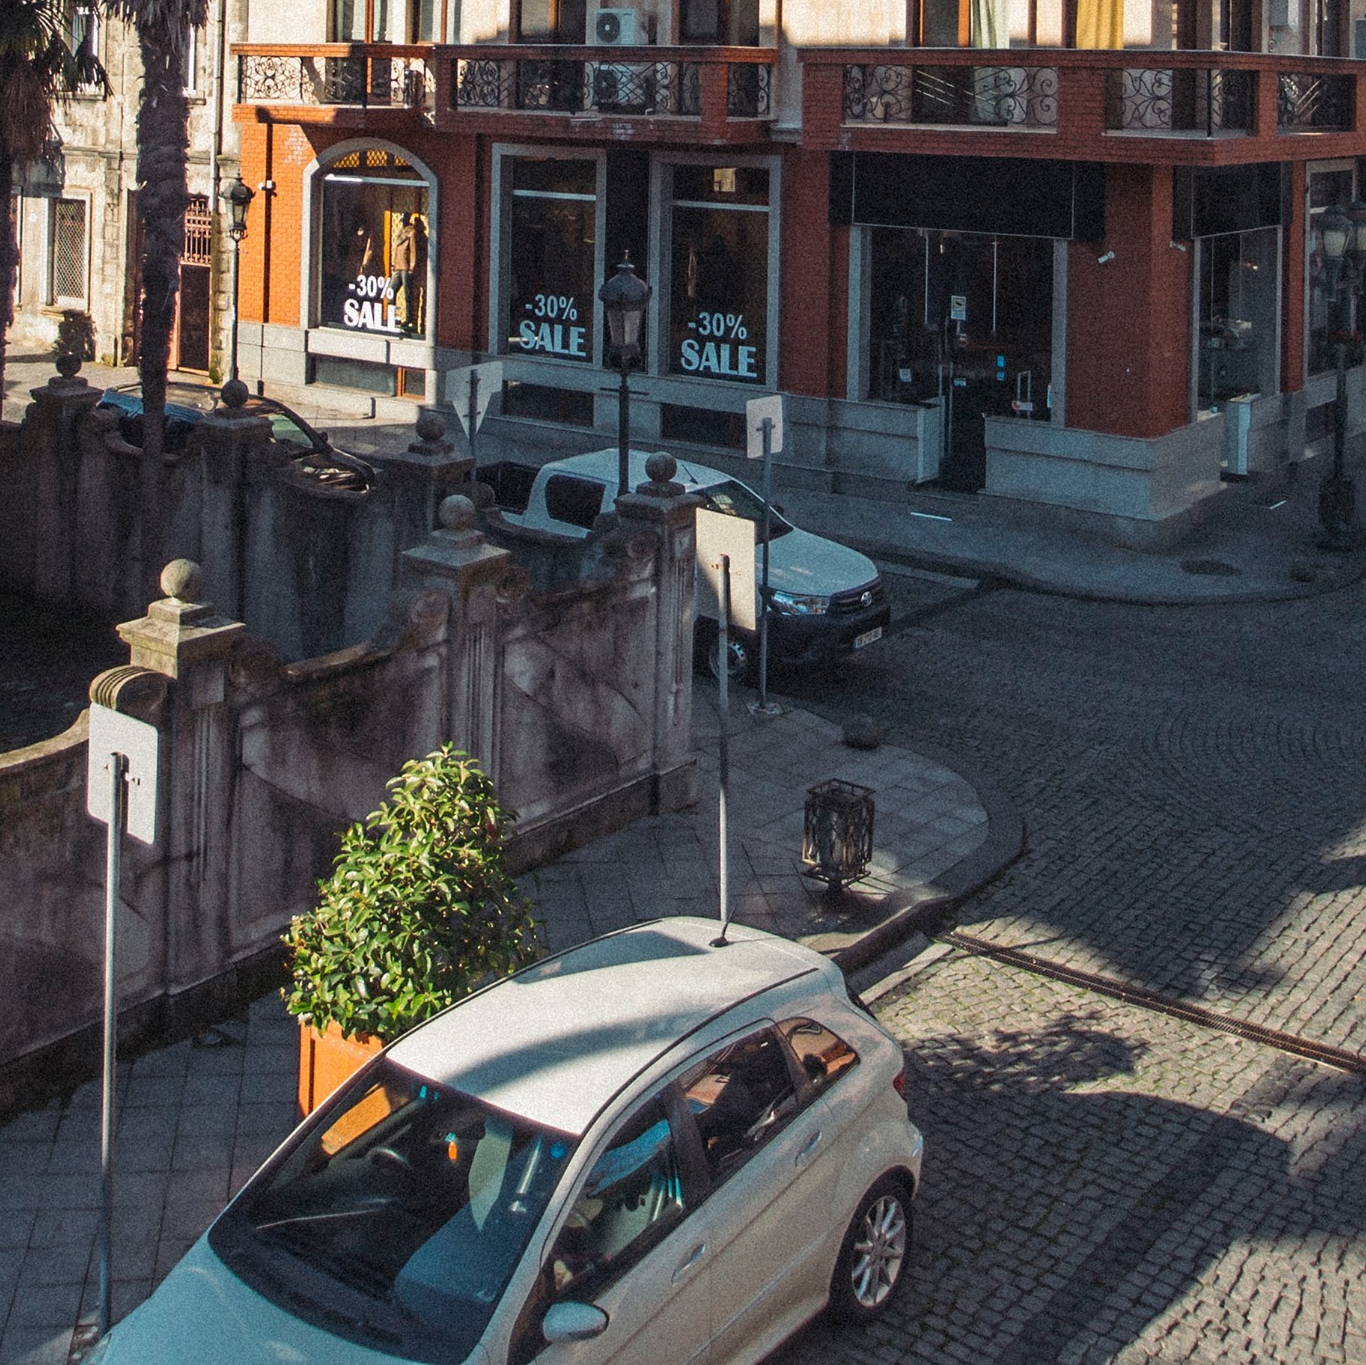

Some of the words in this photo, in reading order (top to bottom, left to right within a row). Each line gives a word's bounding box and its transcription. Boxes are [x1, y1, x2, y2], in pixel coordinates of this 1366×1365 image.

[348, 274, 395, 300] -30%
[343, 298, 402, 334] SALE
[525, 293, 577, 321] -30%
[519, 319, 587, 357] SALE
[687, 311, 748, 340] -30%
[680, 339, 758, 378] SALE
